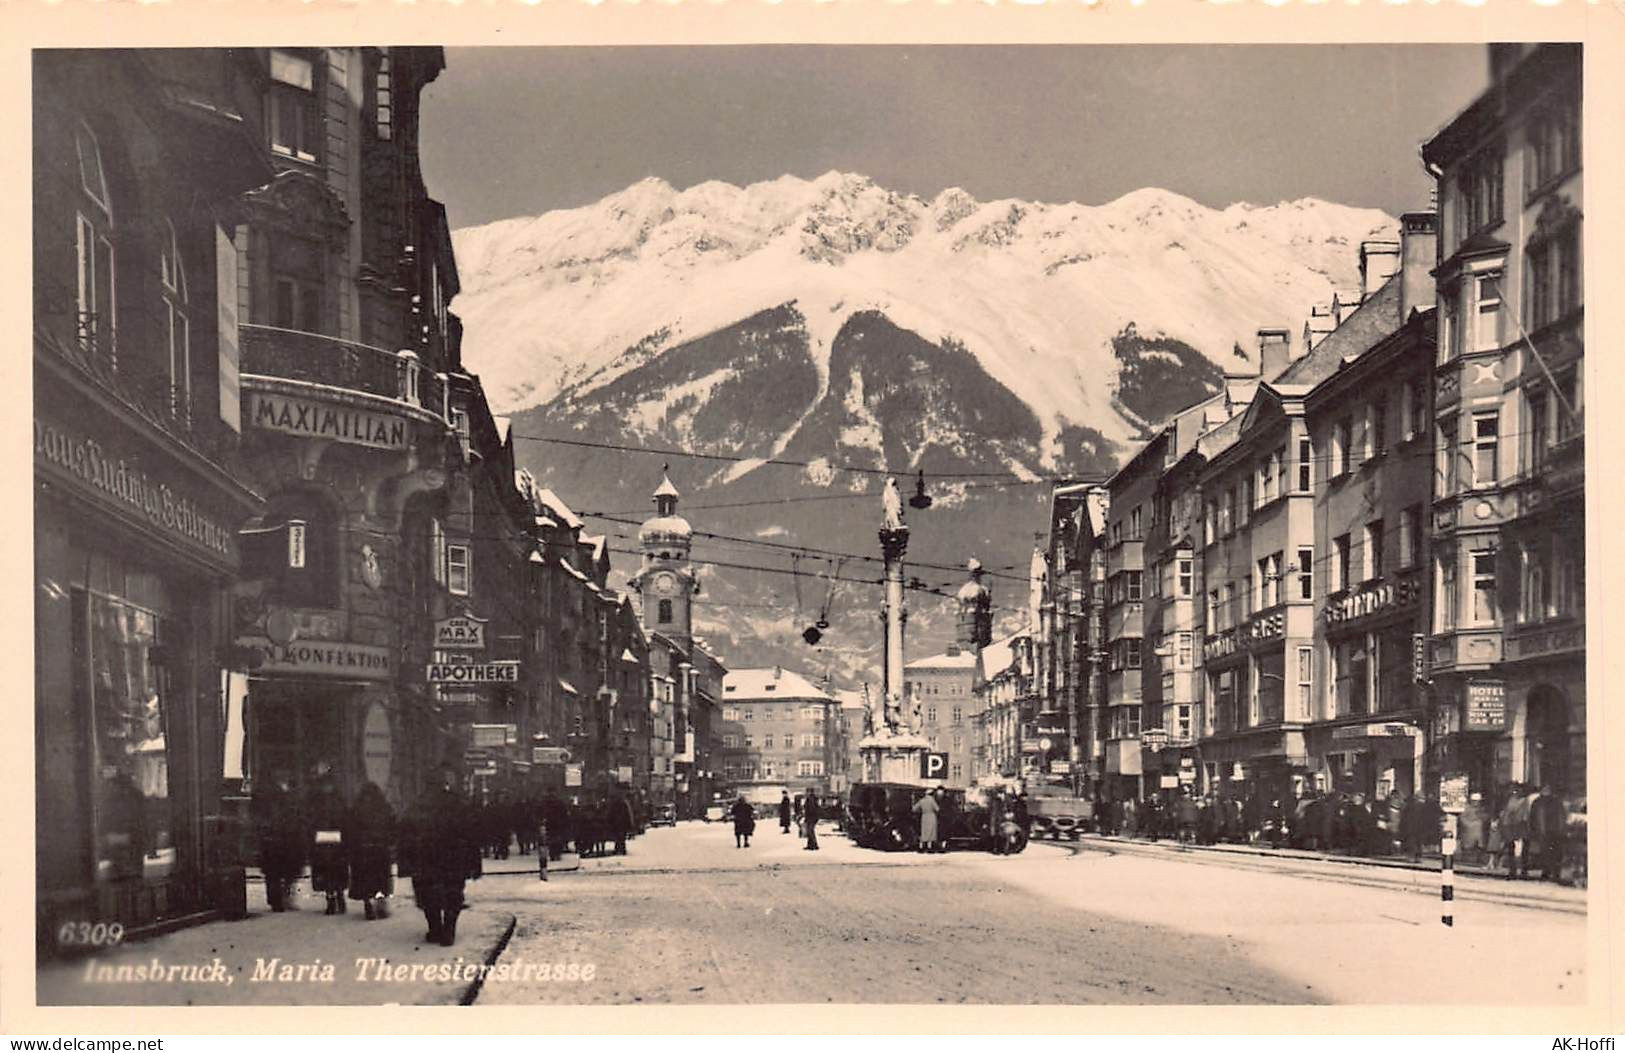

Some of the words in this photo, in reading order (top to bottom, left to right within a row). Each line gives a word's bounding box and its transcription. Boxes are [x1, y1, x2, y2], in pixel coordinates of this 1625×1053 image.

[256, 399, 404, 446] MAXIMILIAN
[87, 439, 160, 526] Ludwig
[160, 483, 229, 553] Schirmer
[440, 627, 478, 637] MAX
[283, 647, 388, 669] KONFEKTION
[430, 666, 515, 679] APOTHEKE
[1469, 687, 1504, 696] HOTEL
[927, 755, 944, 777] P
